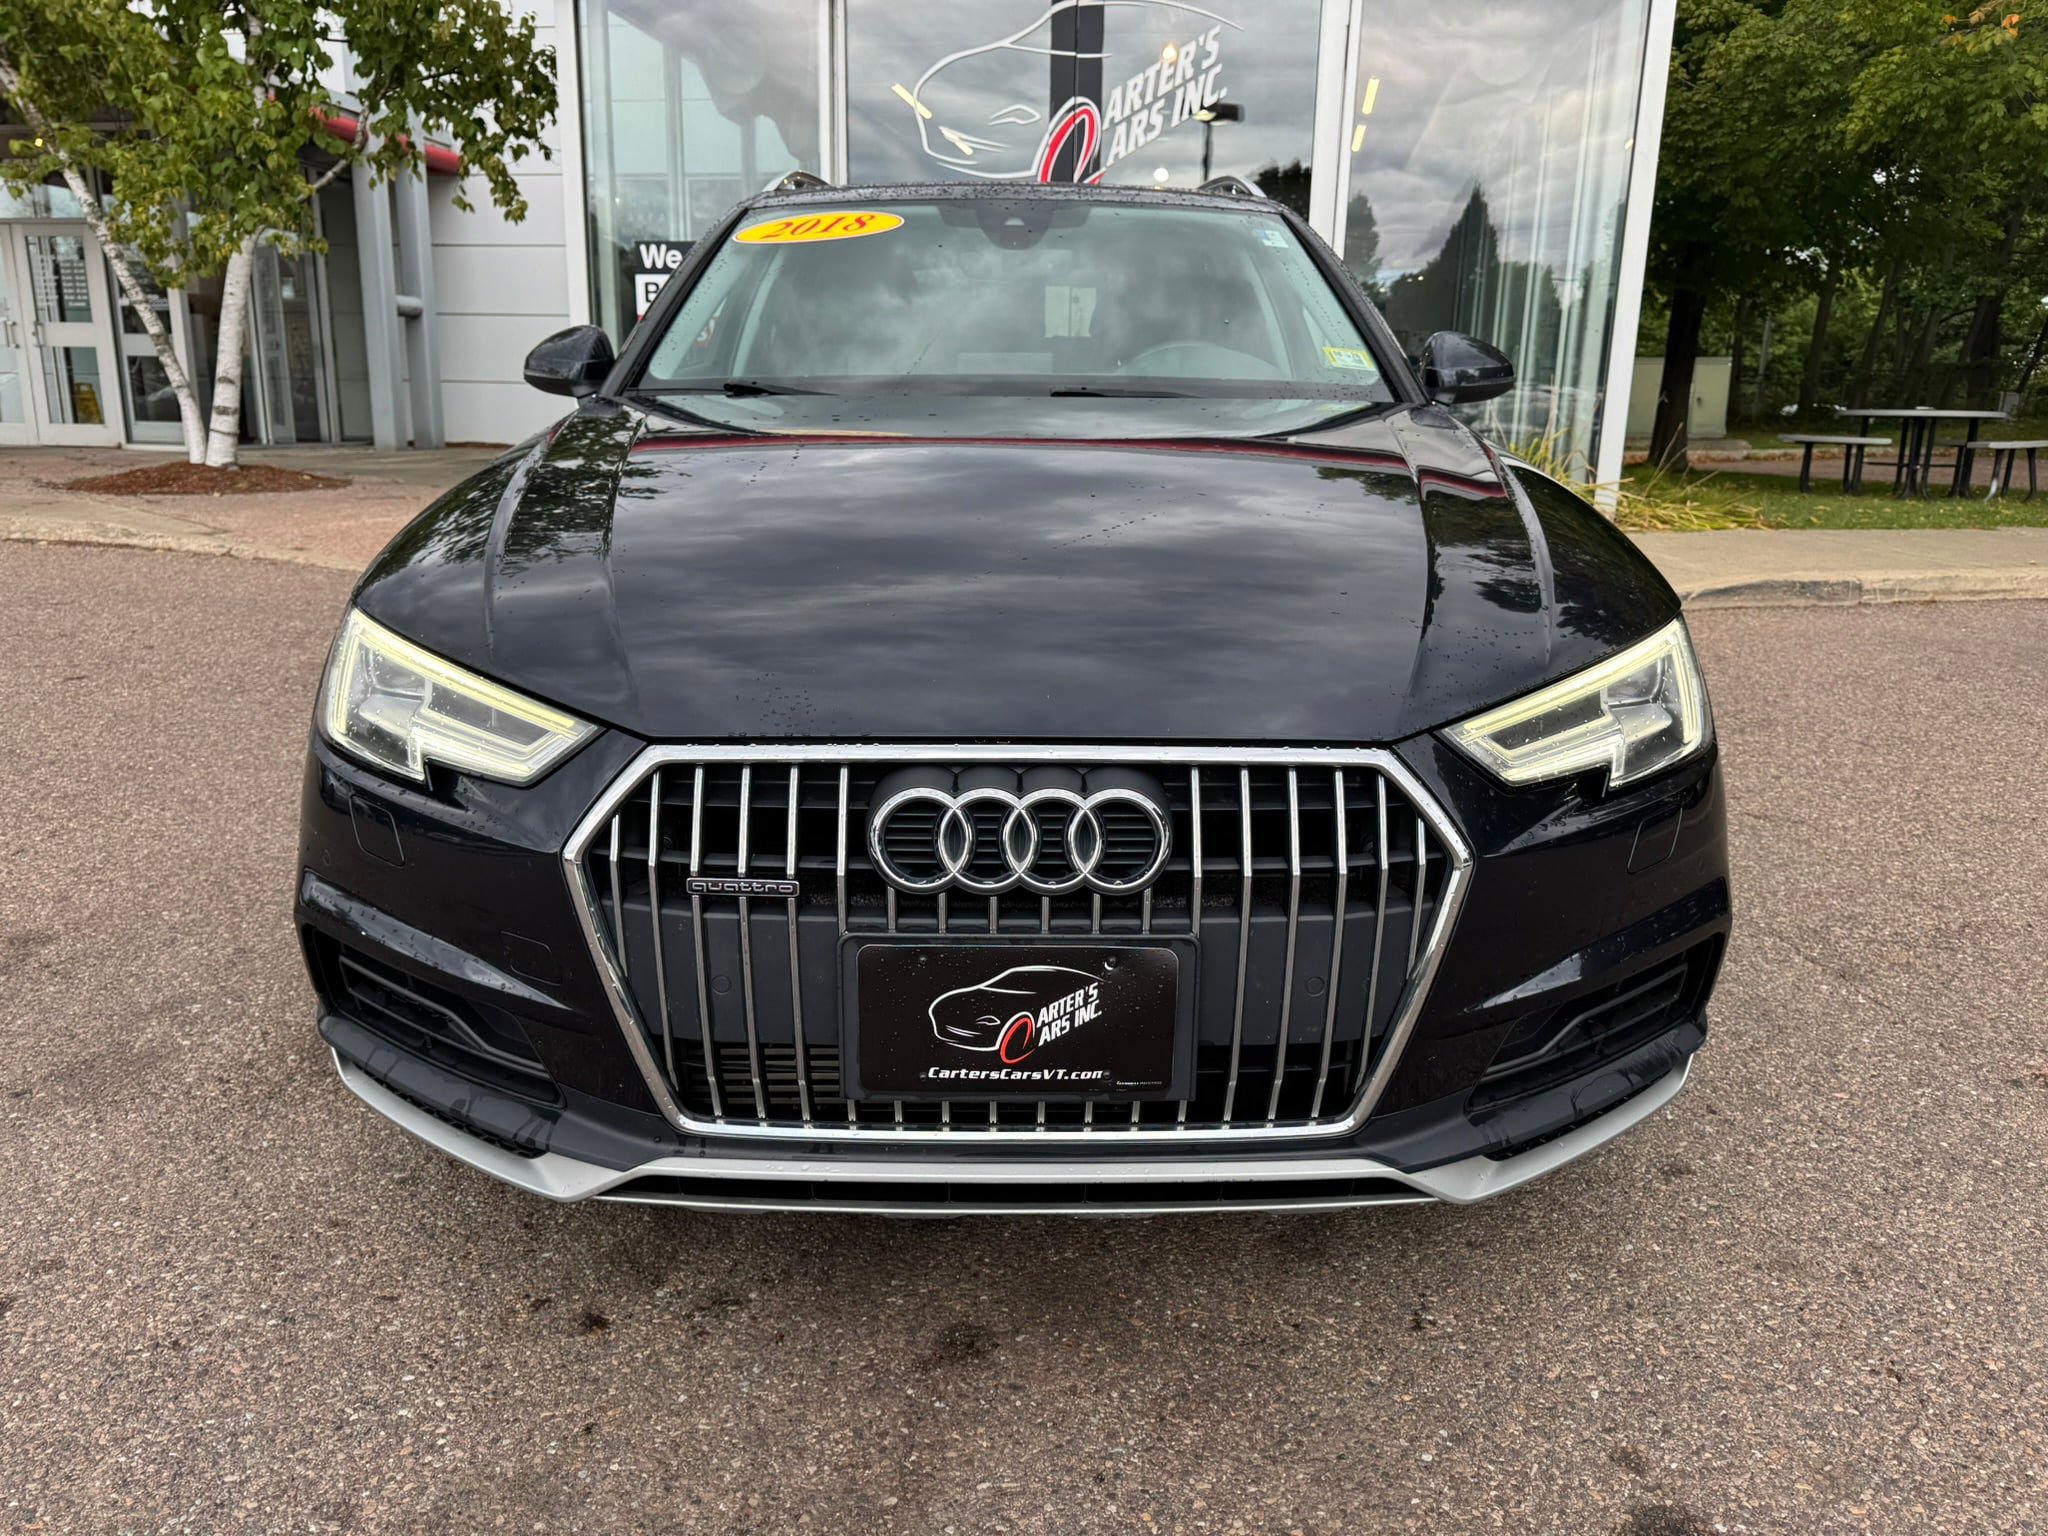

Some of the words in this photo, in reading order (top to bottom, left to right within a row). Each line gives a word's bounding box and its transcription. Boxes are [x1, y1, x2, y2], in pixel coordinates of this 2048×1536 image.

[1170, 63, 1228, 128] INC.
[760, 214, 875, 239] 2018
[639, 243, 683, 269] We
[691, 881, 794, 893] quattro
[1074, 1000, 1102, 1028] INC.
